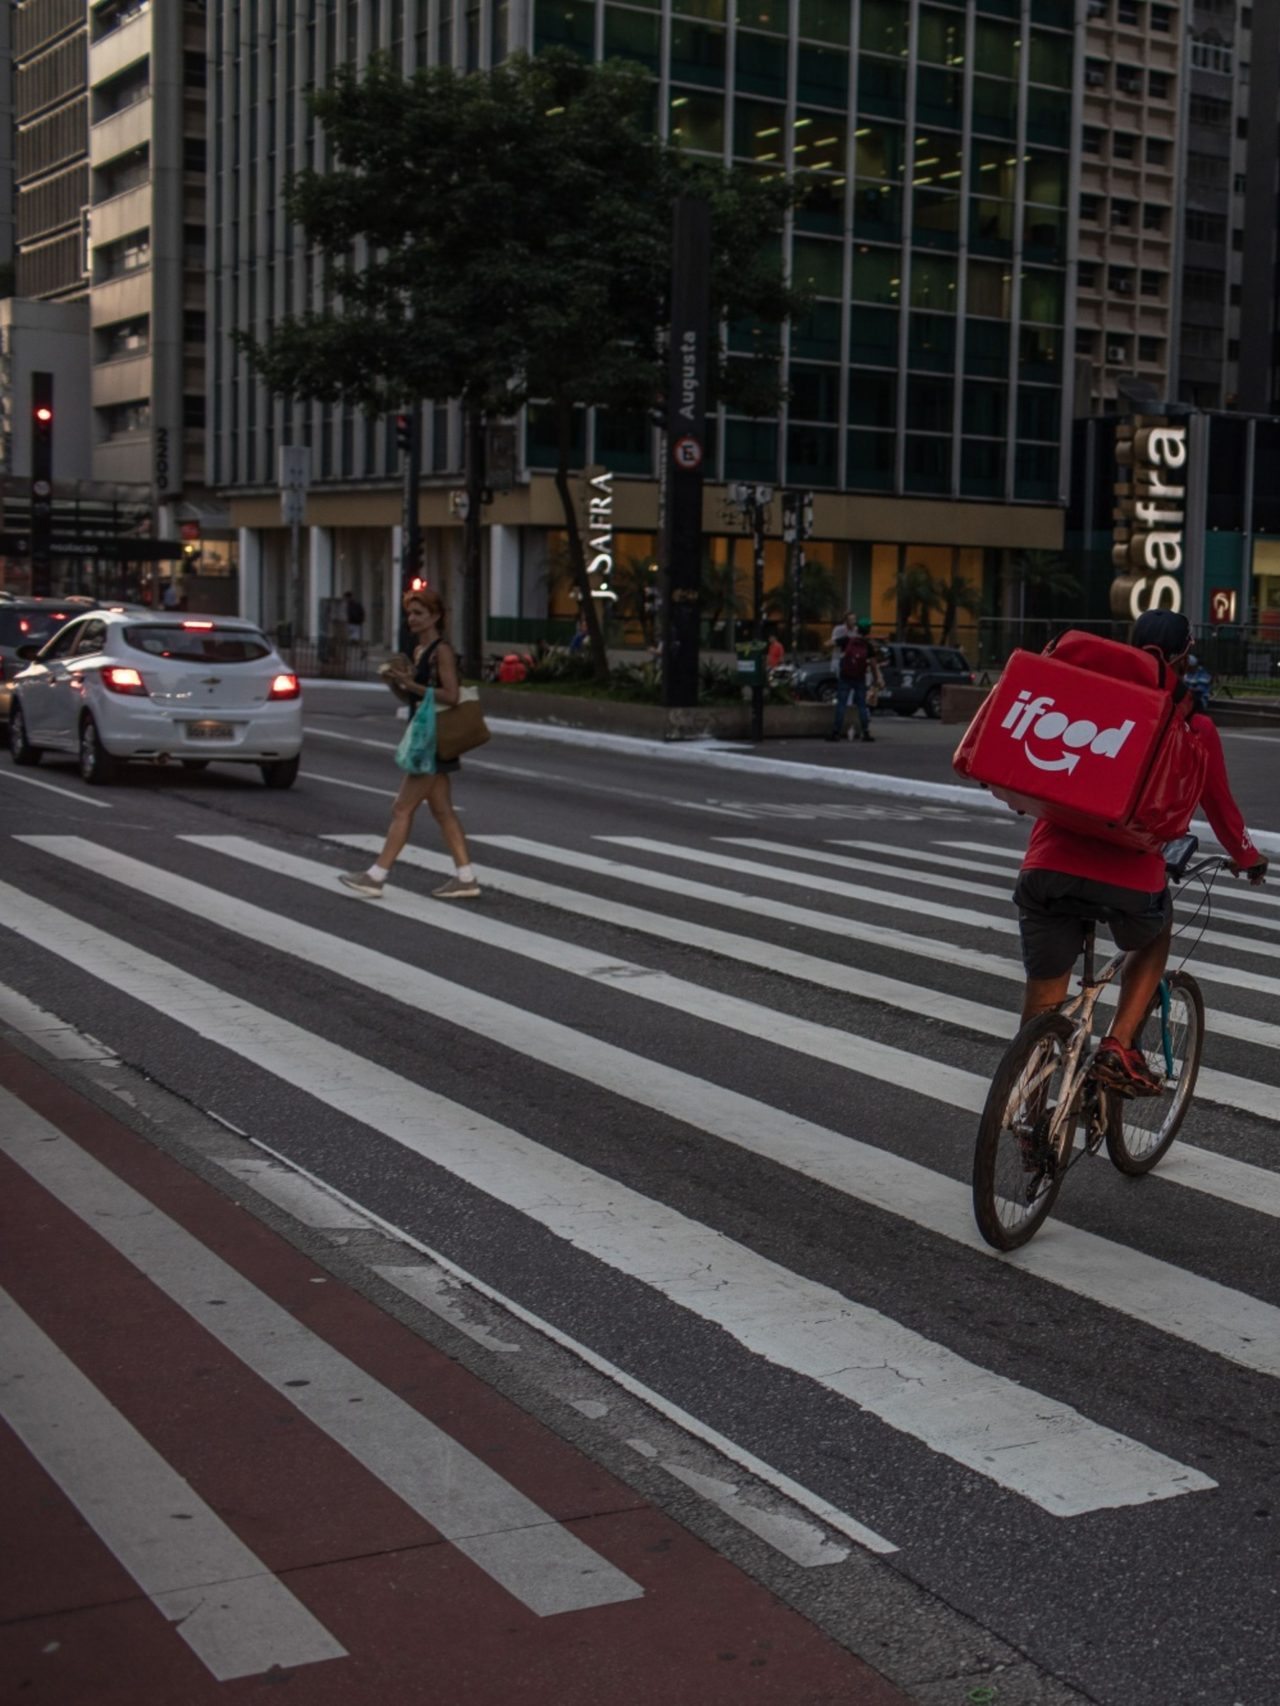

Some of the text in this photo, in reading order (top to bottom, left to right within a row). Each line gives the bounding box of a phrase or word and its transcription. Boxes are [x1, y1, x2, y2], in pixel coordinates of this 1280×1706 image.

[678, 330, 699, 421] Augusta
[157, 428, 168, 489] 2200
[586, 471, 614, 575] SAFRA
[1130, 426, 1187, 621] Safra
[1001, 689, 1137, 760] ifood
